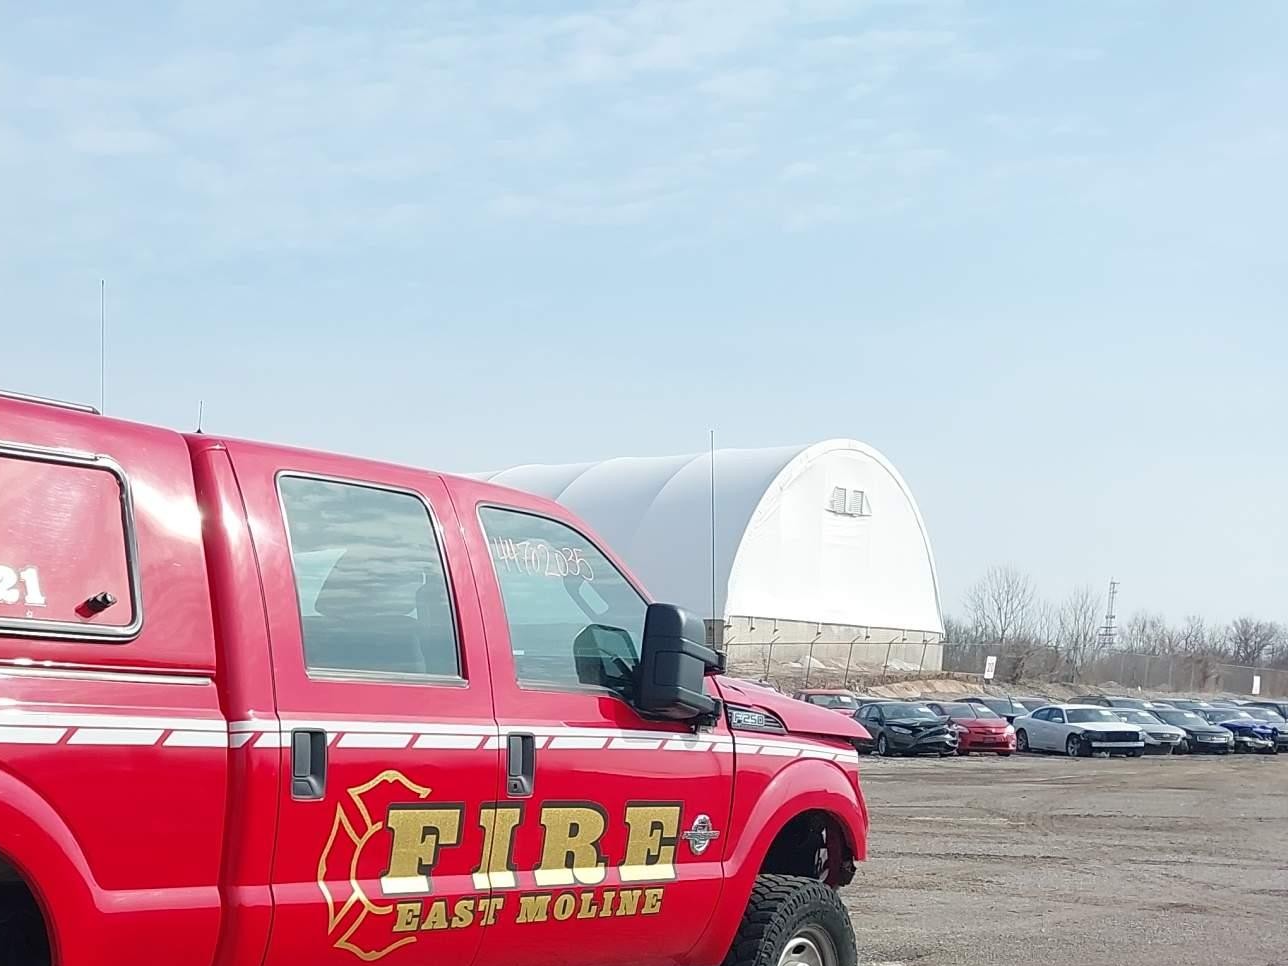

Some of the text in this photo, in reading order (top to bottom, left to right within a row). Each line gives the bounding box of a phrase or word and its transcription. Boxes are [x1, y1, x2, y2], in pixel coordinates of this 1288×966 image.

[493, 537, 594, 582] 44702035
[379, 800, 683, 897] FIRE
[392, 888, 665, 933] EAST MOLINE
